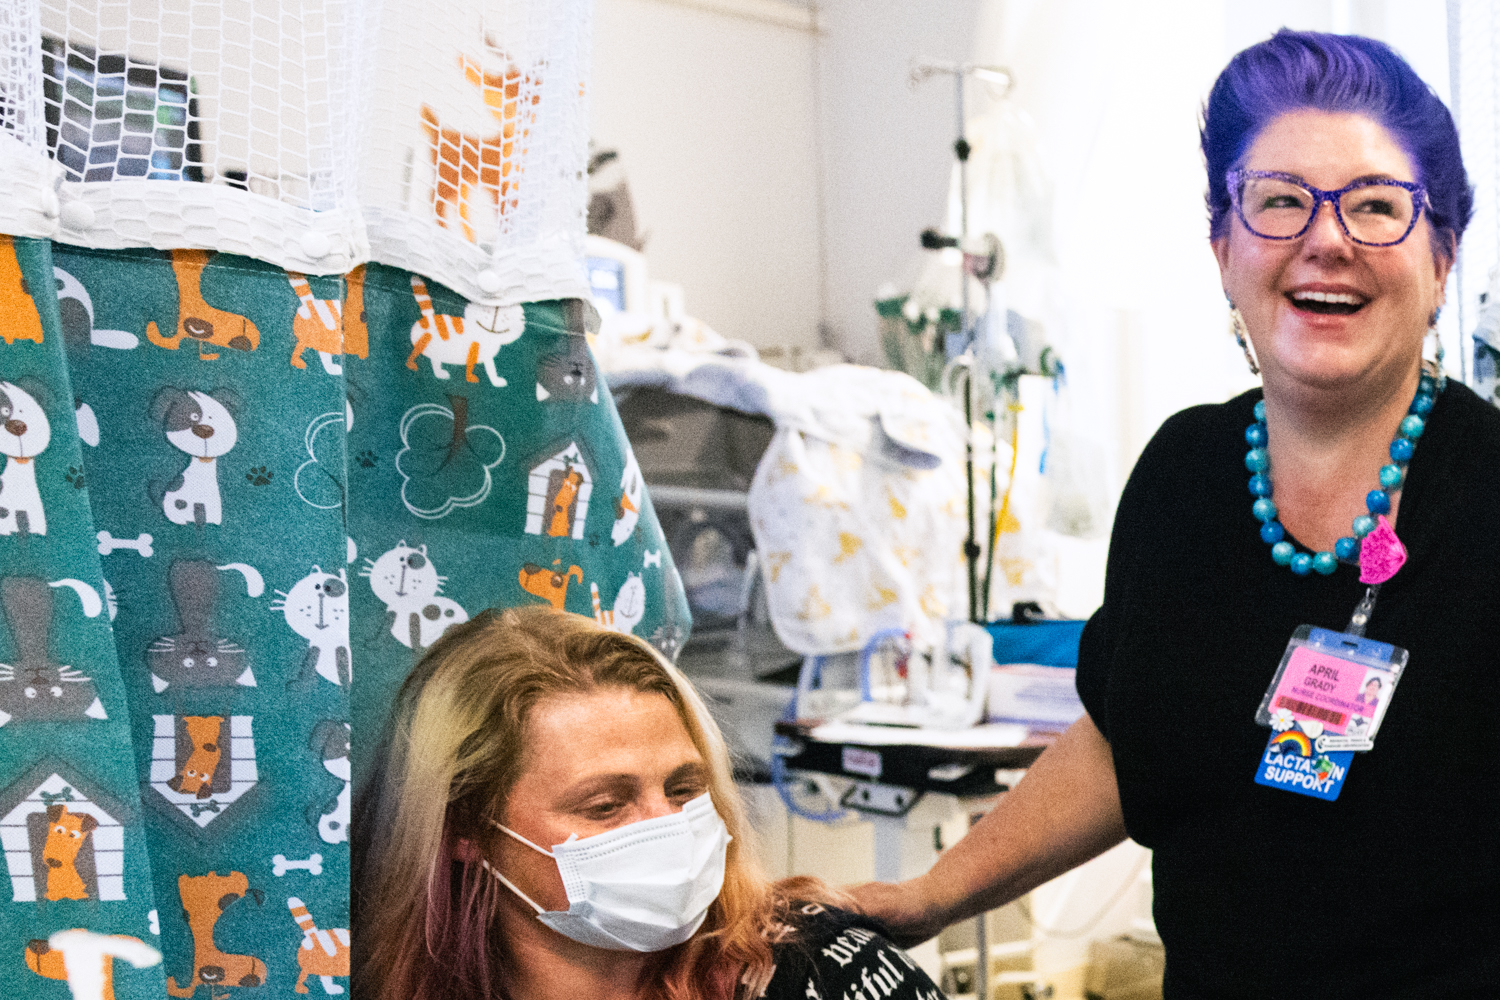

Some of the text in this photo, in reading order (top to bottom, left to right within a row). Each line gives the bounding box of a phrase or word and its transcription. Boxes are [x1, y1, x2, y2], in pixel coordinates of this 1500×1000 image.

[1309, 664, 1340, 681] APRIL
[1292, 687, 1315, 698] NURSE
[1304, 677, 1337, 693] GRADY
[1264, 765, 1335, 794] SUPPORT
